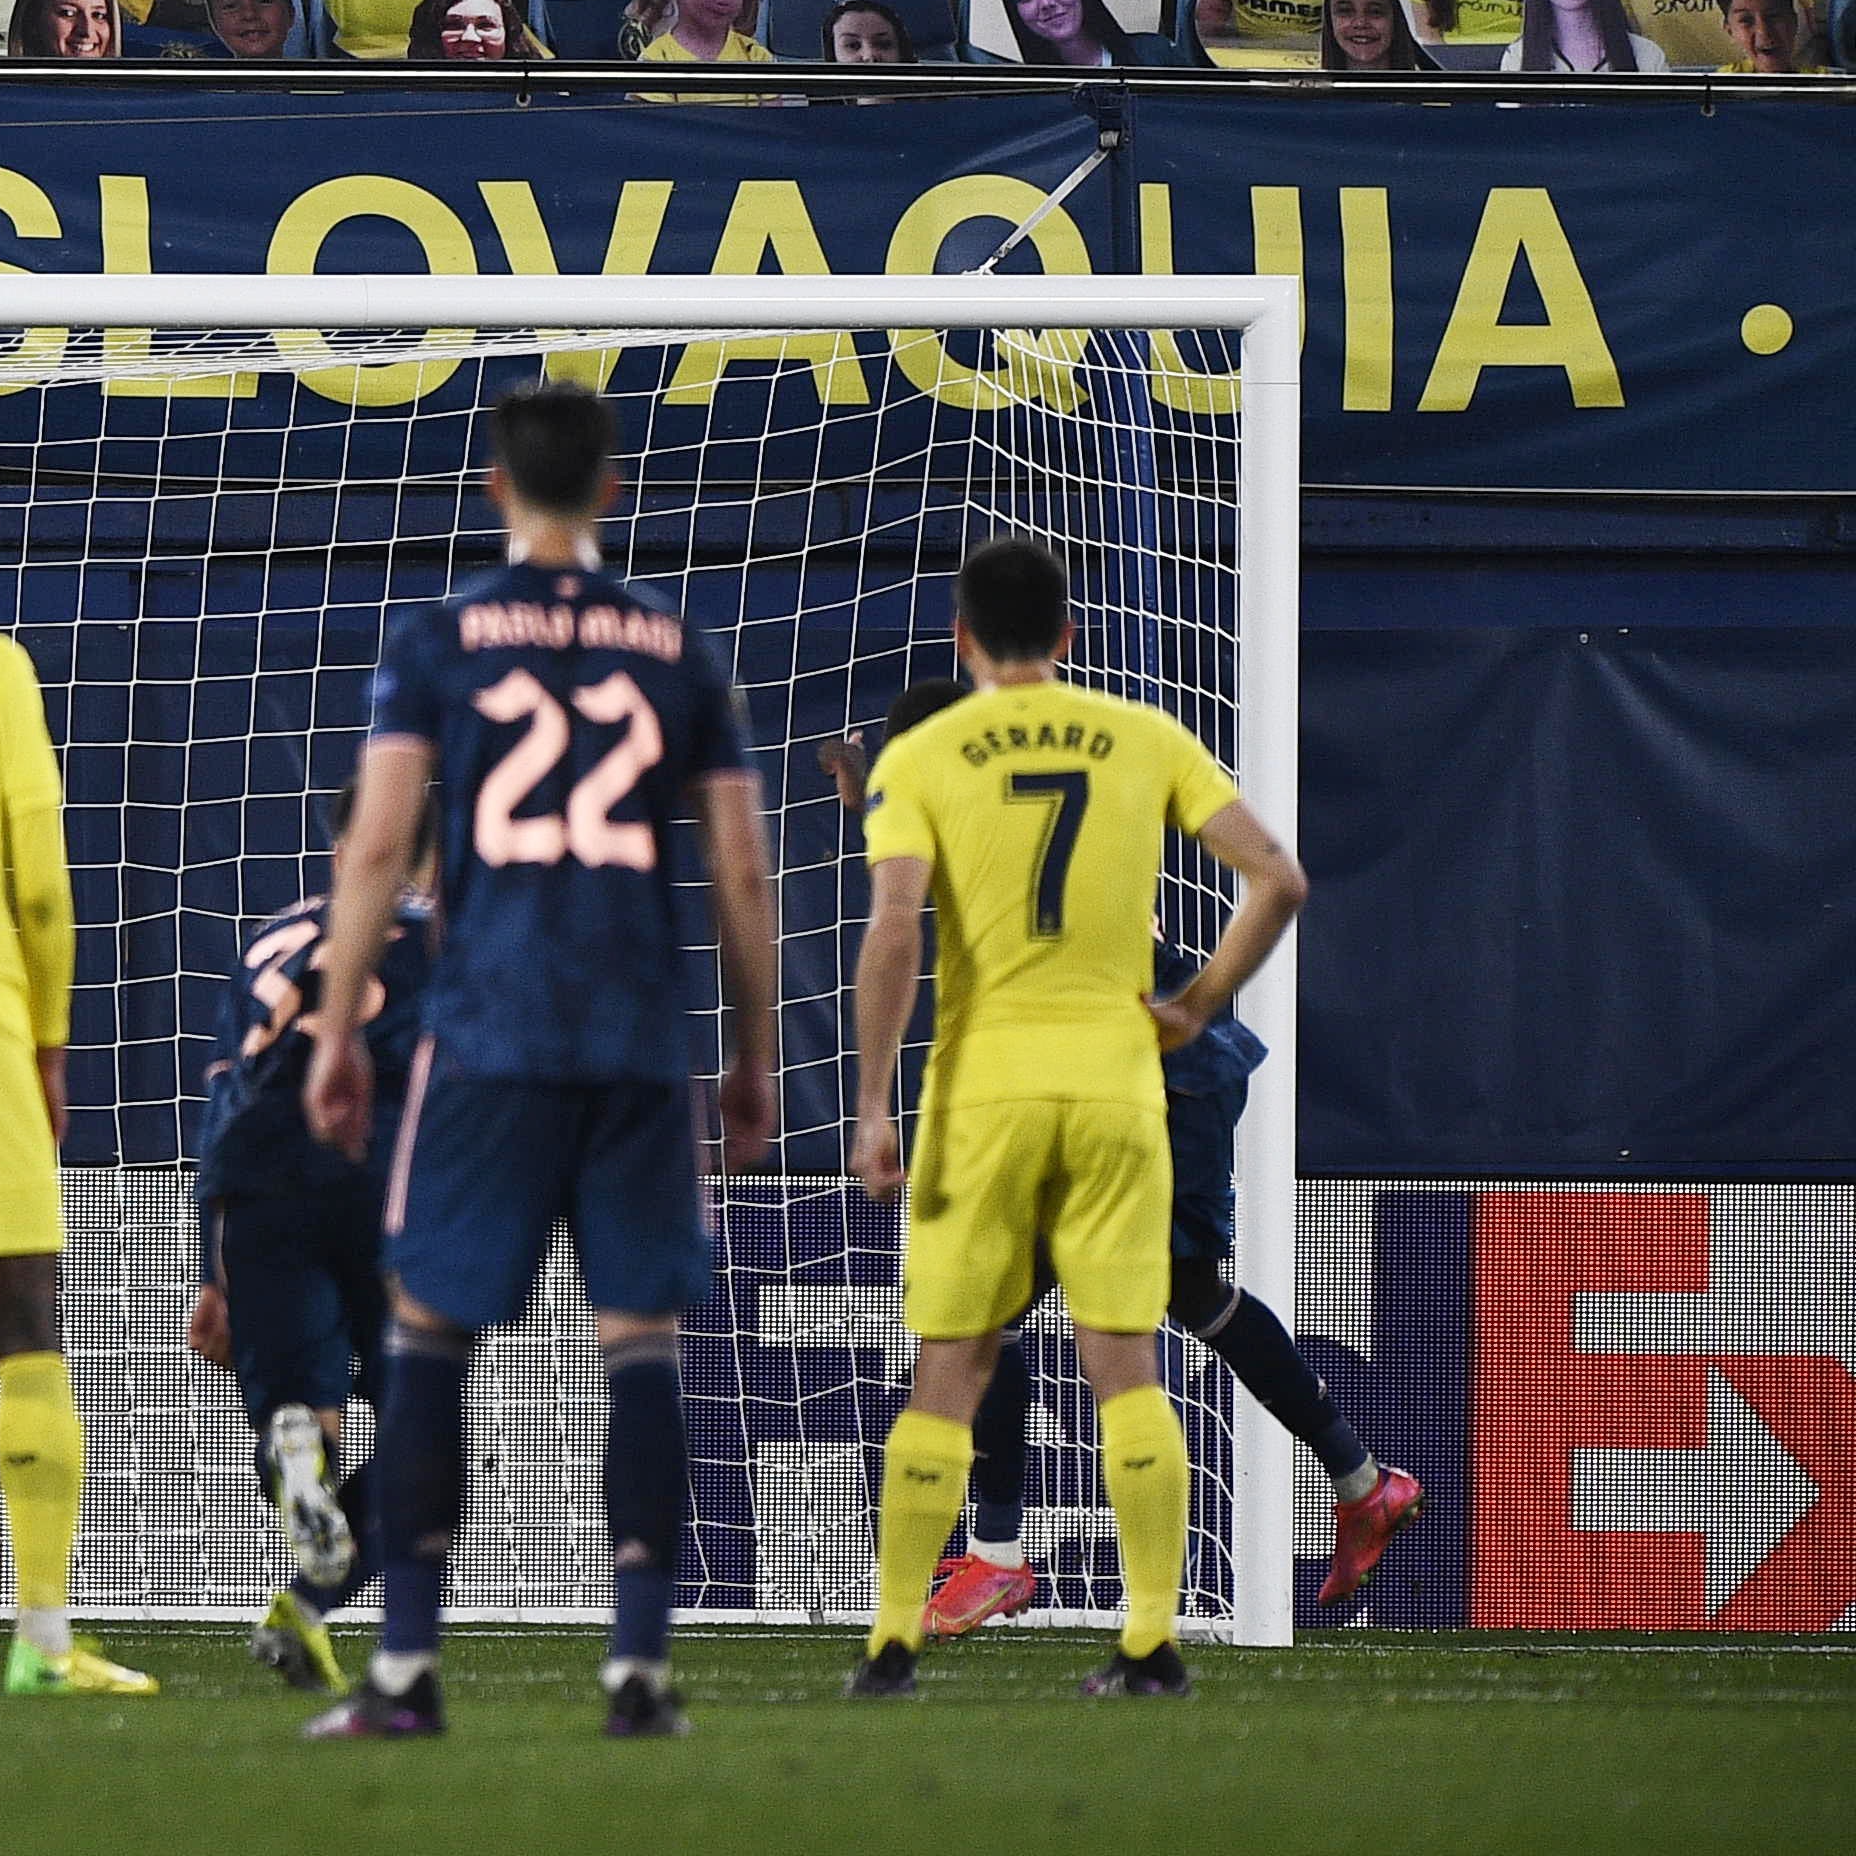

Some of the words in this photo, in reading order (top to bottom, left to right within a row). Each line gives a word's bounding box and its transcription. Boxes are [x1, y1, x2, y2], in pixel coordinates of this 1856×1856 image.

[470, 666, 664, 873] 22
[961, 726, 1115, 770] GERARD
[1002, 769, 1089, 939] 7
